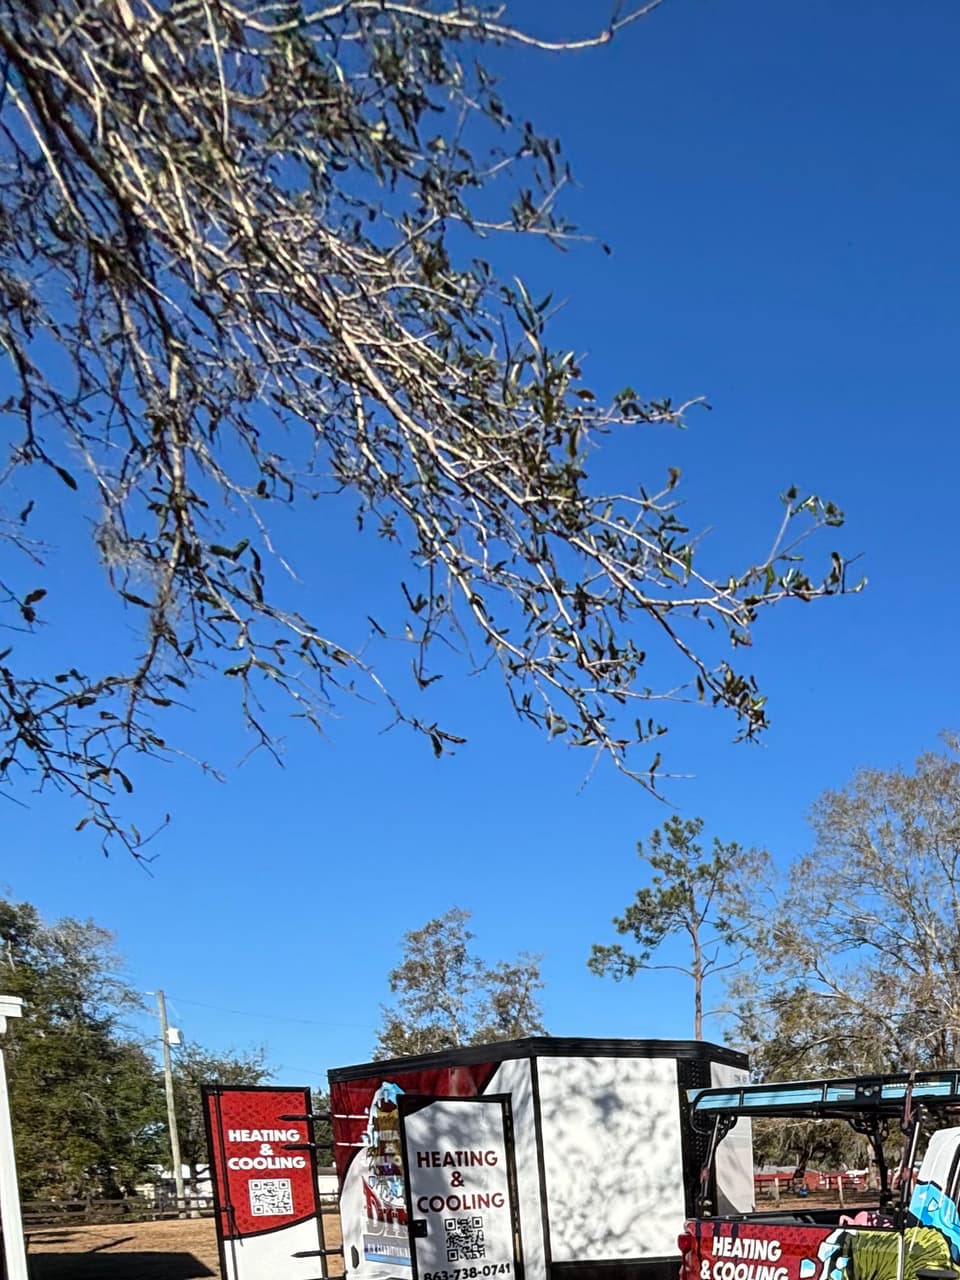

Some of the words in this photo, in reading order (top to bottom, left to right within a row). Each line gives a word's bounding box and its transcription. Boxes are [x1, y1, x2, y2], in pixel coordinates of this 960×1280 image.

[228, 1129, 300, 1142] HEATING
[259, 1143, 274, 1156] &
[228, 1156, 306, 1170] COOLING
[416, 1151, 498, 1168] HEATING
[450, 1171, 465, 1187] &
[417, 1193, 505, 1213] COOLING
[712, 1236, 782, 1262] HEATING
[700, 1260, 711, 1280] &
